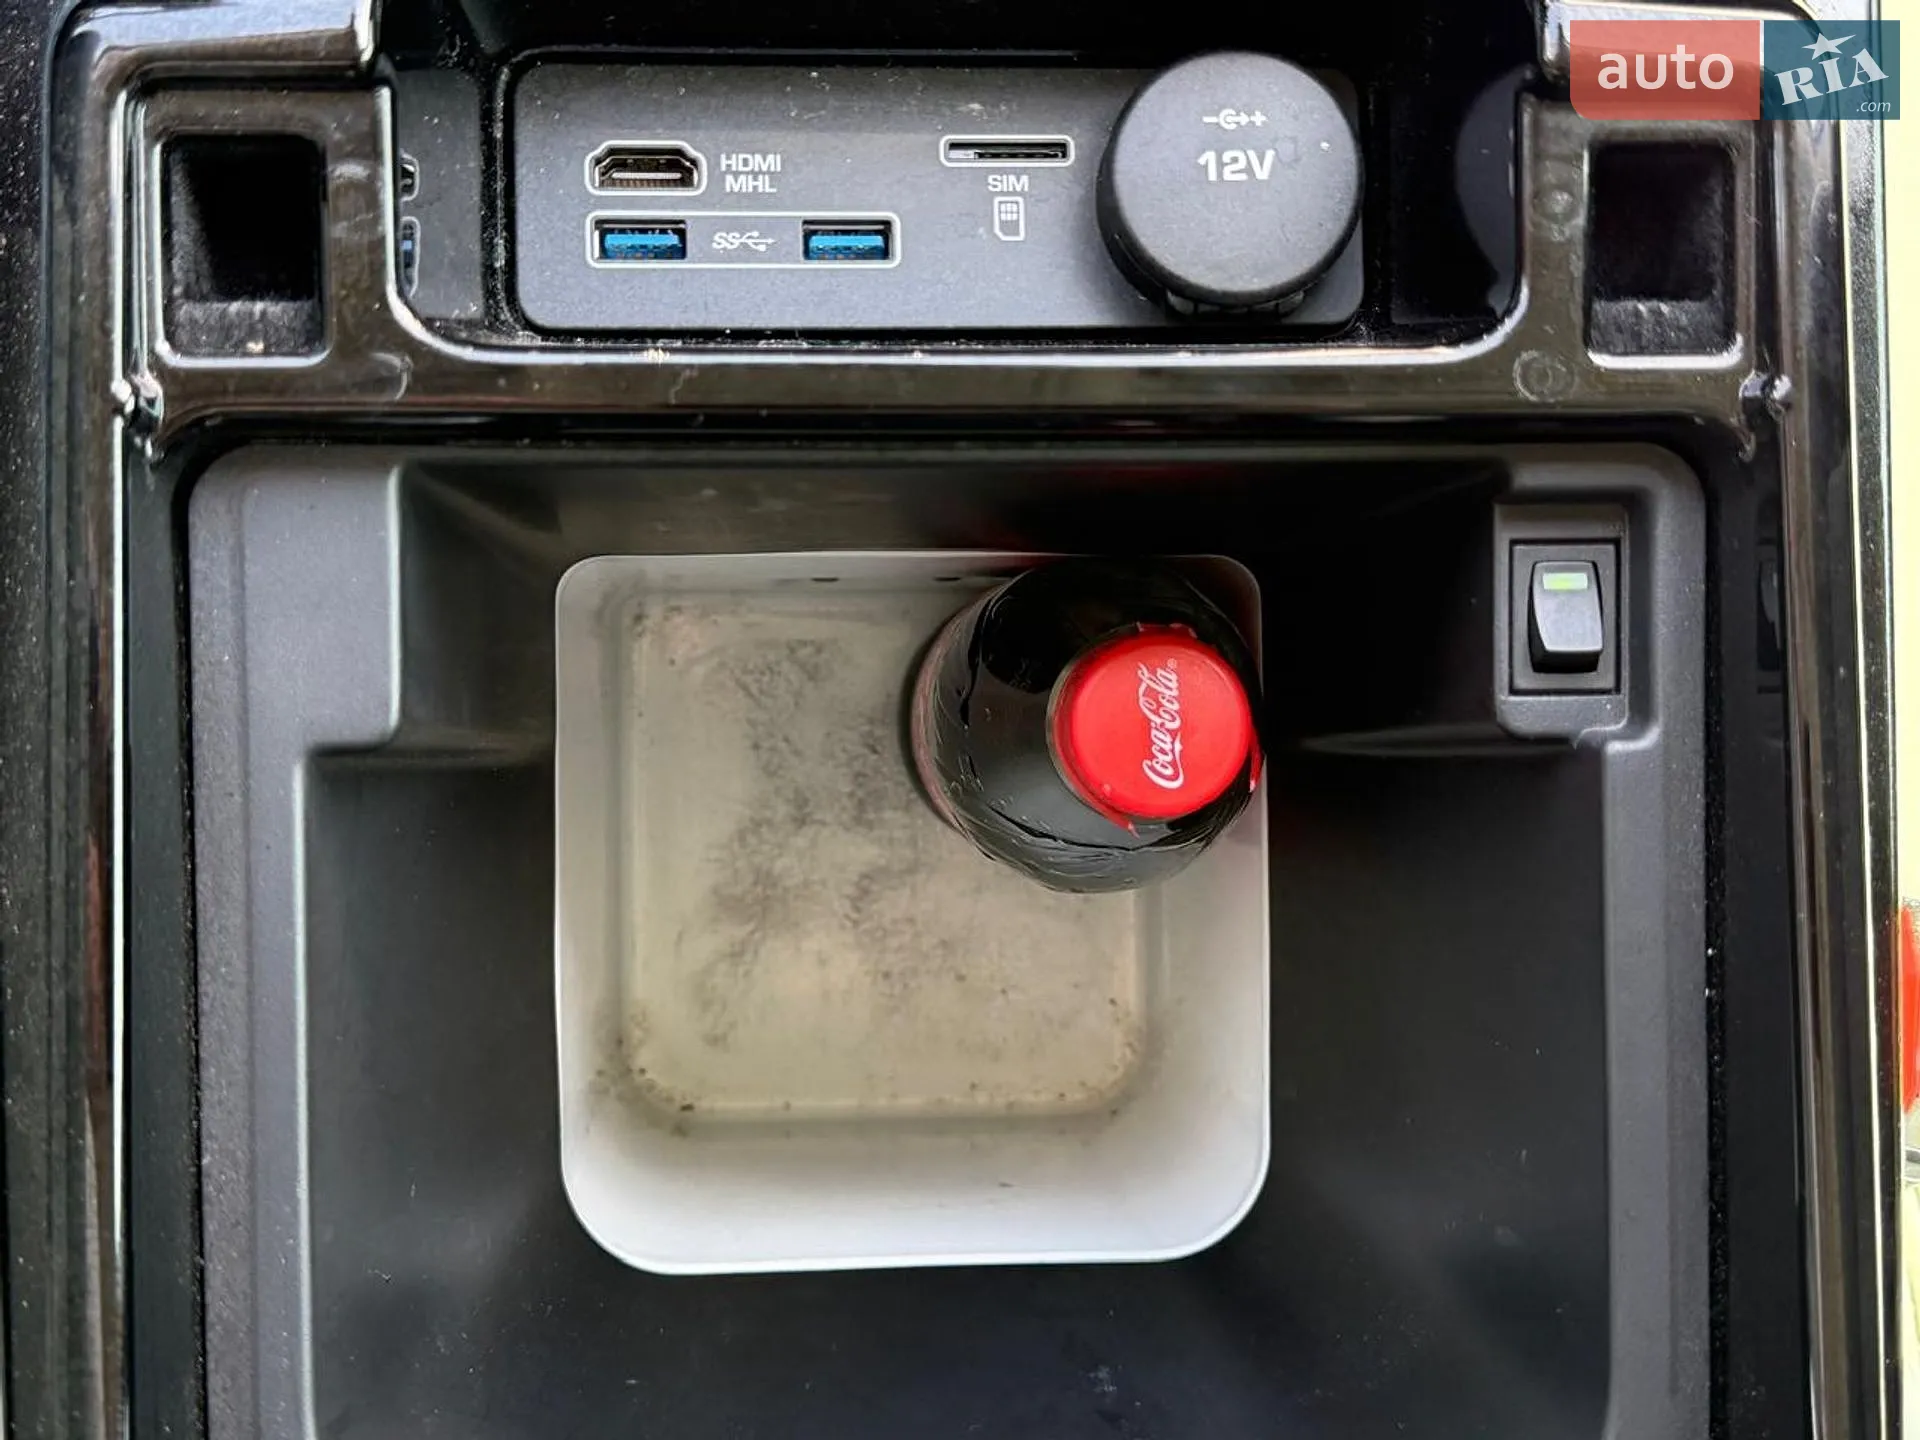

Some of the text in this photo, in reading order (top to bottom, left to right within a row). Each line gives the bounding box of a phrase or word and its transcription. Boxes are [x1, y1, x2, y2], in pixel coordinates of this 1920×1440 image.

[719, 153, 782, 172] HDMI
[1197, 149, 1276, 182] 12V
[724, 174, 777, 193] MHL
[987, 174, 1029, 192] SIM
[1137, 661, 1184, 789] Coca-Cola
